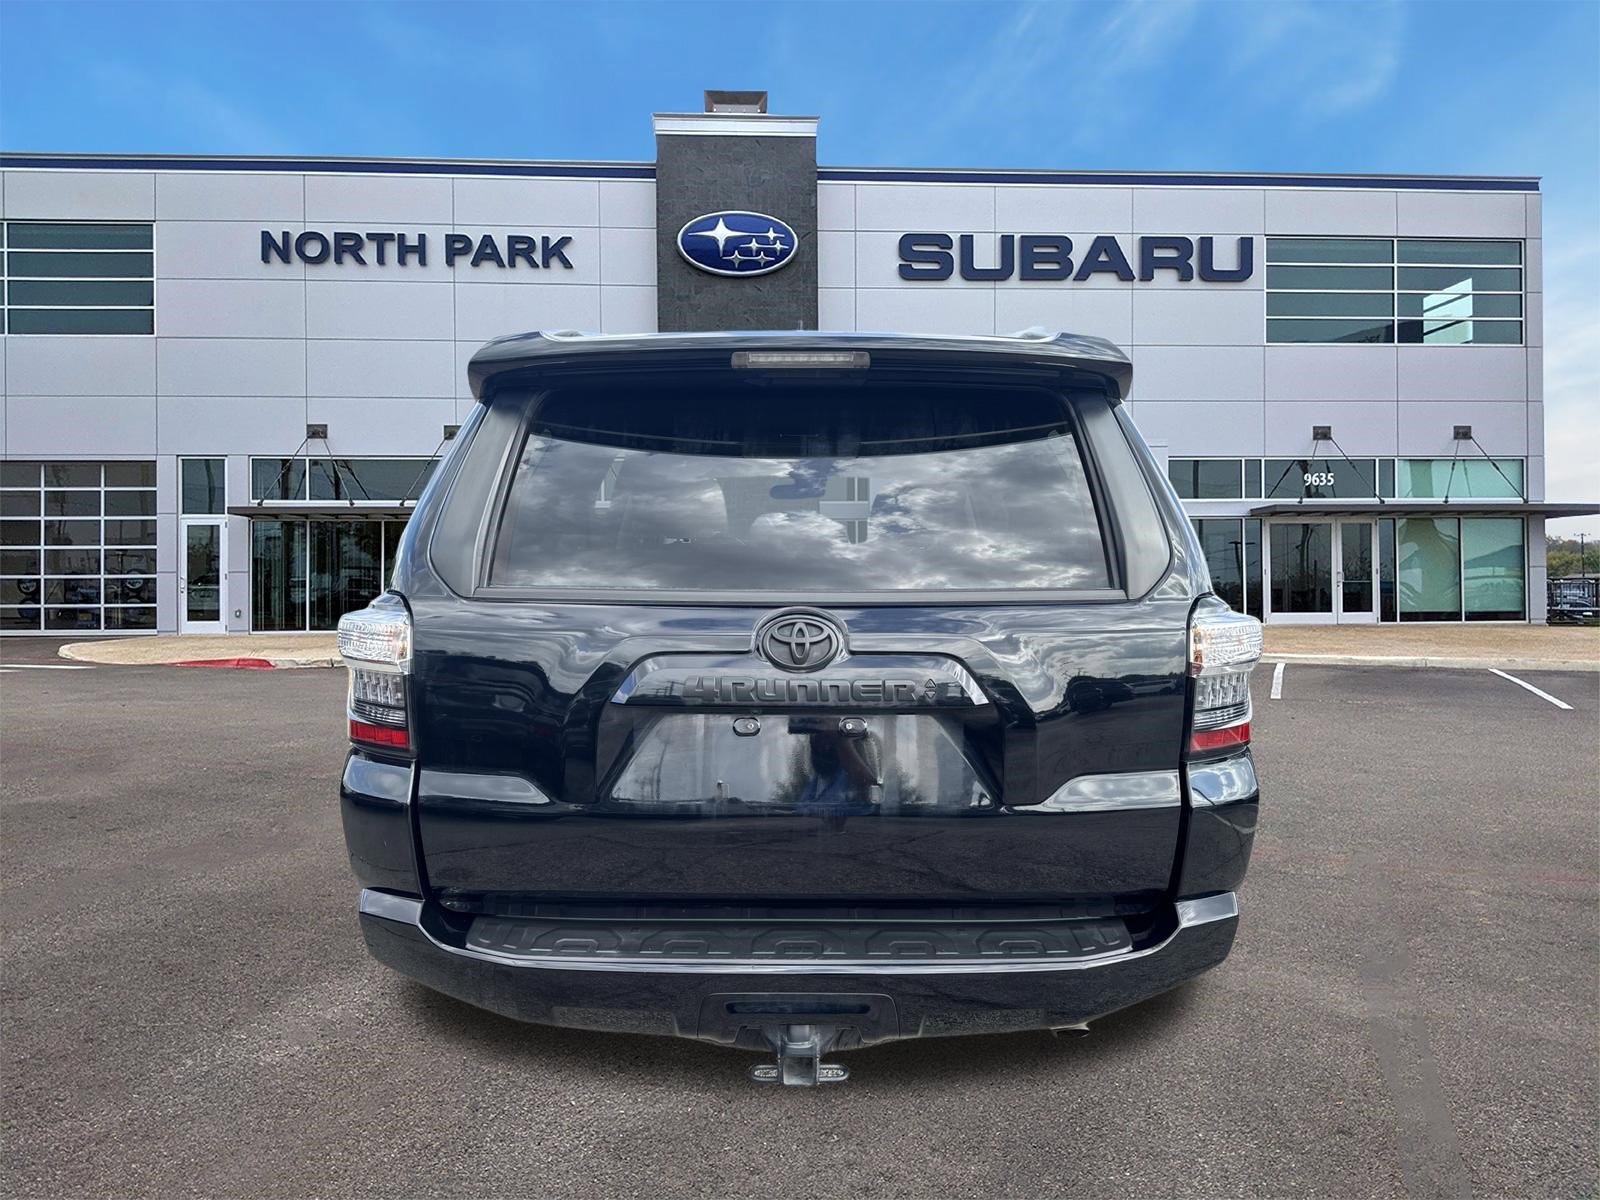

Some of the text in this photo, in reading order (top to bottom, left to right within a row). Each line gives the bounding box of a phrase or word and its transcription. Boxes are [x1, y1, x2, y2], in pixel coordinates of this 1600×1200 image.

[260, 230, 574, 269] NORTH PARK
[898, 233, 1254, 283] SUBARU
[1303, 472, 1335, 486] 9635
[683, 676, 918, 703] 4RUNNER
